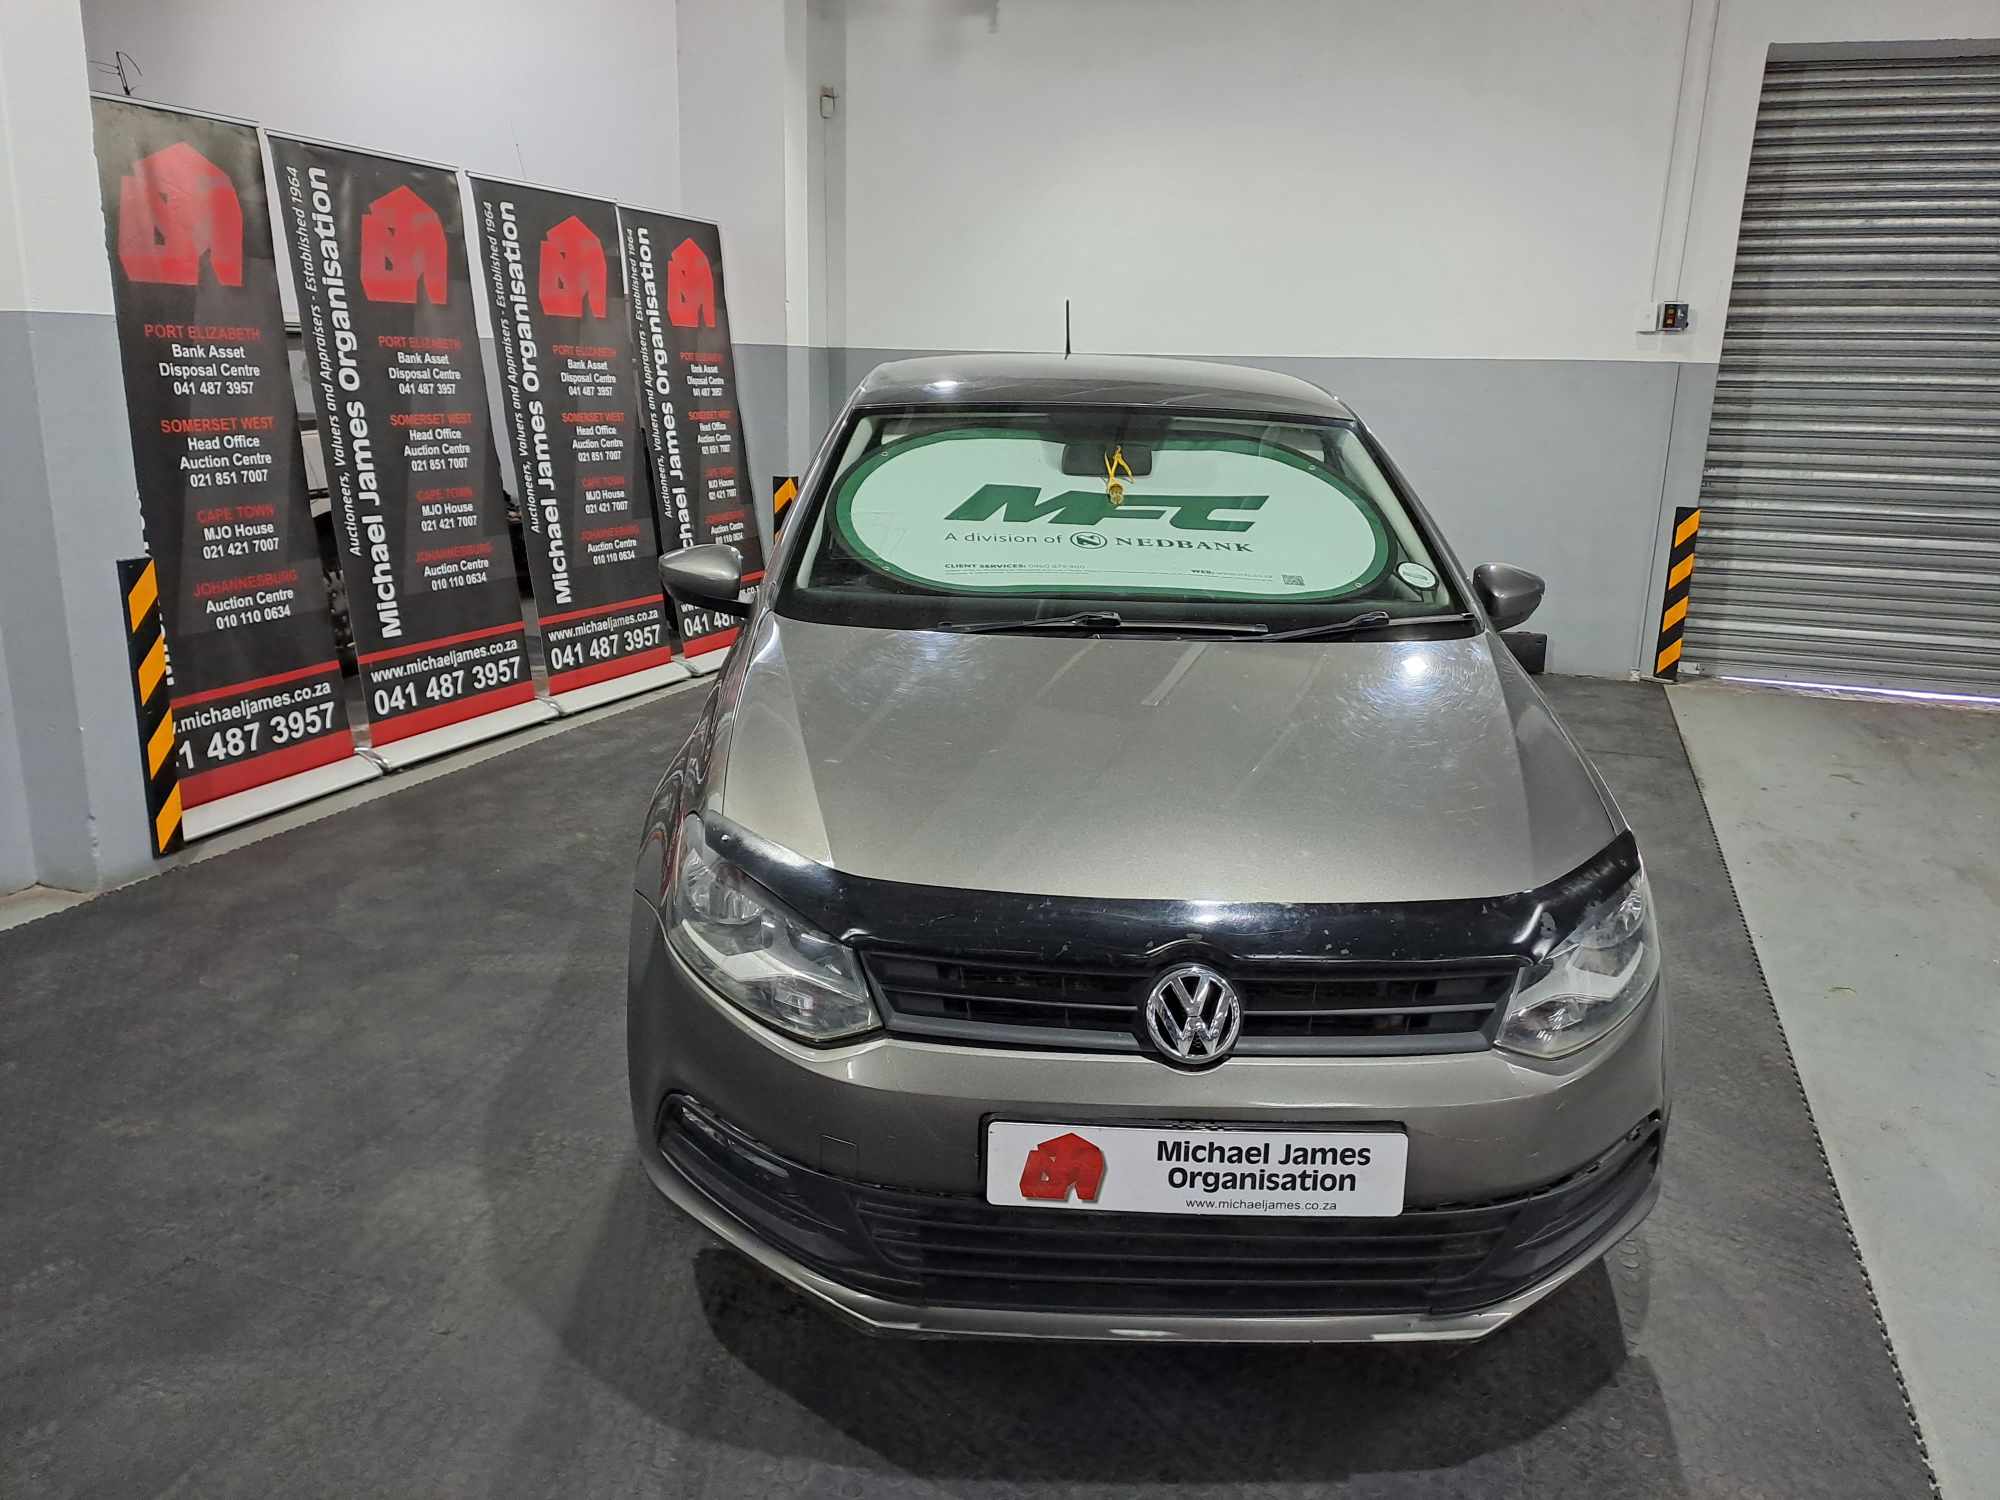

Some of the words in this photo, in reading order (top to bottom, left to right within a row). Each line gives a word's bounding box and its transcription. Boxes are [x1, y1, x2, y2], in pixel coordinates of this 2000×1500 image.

[286, 166, 305, 205] 1964
[483, 201, 497, 235] 1964
[292, 208, 317, 293] Established
[308, 167, 360, 392] Organisation
[487, 235, 506, 307] Established
[499, 201, 540, 393] Organisation
[630, 258, 644, 321] Established
[638, 227, 670, 395] Organisation
[144, 324, 184, 339] PORT
[188, 325, 261, 341] ELIZABETH
[310, 305, 333, 383] Appraisers
[378, 335, 406, 348] PORT
[172, 343, 206, 358] Bank
[209, 345, 246, 358] Asset
[397, 352, 422, 364] Bank
[424, 352, 450, 364] Asset
[500, 317, 519, 385] Appraisers
[639, 330, 653, 388] Appraisers
[159, 363, 217, 379] Disposal
[221, 363, 261, 377] Centre
[388, 367, 430, 381] Disposal
[432, 368, 461, 379] Centre
[567, 359, 586, 370] Bank
[587, 360, 608, 370] Asset
[174, 381, 196, 395] 041
[200, 381, 222, 395] 487
[226, 381, 254, 394] 3957
[399, 383, 415, 395] 041
[418, 383, 433, 394] 487
[437, 383, 456, 394] 3957
[560, 372, 593, 384] Disposal
[321, 382, 337, 411] and
[509, 384, 522, 409] and
[161, 417, 237, 433] SOMERSET
[241, 416, 275, 430] WEST
[409, 428, 433, 440] Head
[435, 428, 461, 439] Office
[514, 411, 529, 457] Valuers
[576, 425, 594, 435] Head
[595, 425, 616, 435] Office
[188, 437, 220, 451] Head
[223, 435, 260, 449] Office
[329, 416, 345, 467] Valuers
[346, 401, 380, 506] James
[404, 445, 440, 457] Auction
[442, 443, 470, 454] Centre
[529, 400, 555, 491] James
[572, 439, 599, 449] Auction
[661, 402, 684, 481] James
[180, 454, 230, 470] Auction
[233, 453, 272, 467] Centre
[411, 460, 428, 472] 021
[430, 459, 446, 470] 851
[448, 457, 468, 469] 7007
[190, 473, 212, 487] 021
[216, 471, 238, 485] 851
[241, 469, 269, 484] 7007
[422, 504, 442, 517] MJO
[444, 502, 473, 514] House
[522, 460, 541, 535] Auctioneers,
[944, 484, 1270, 532] MFC
[197, 508, 232, 523] CAPE
[237, 504, 275, 519] TOWN
[336, 472, 362, 556] Auctioneers,
[421, 520, 437, 532] 021
[440, 518, 455, 529] 421
[457, 515, 477, 527] 7007
[204, 526, 232, 541] MJO
[235, 523, 274, 538] House
[944, 532, 959, 543] A
[965, 532, 1044, 545] division
[1048, 532, 1063, 544] of
[1115, 537, 1255, 552] NEDBANK
[203, 545, 223, 559] 021
[228, 542, 249, 556] 421
[253, 537, 280, 553] 7007
[540, 498, 572, 604] Michael
[587, 541, 613, 553] Auction
[361, 515, 402, 639] Michael
[424, 563, 458, 577] Auction
[460, 559, 489, 571] Centre
[431, 579, 447, 591] 010
[449, 575, 464, 587] 110
[466, 571, 488, 585] 0634
[206, 597, 253, 614] Auction
[256, 589, 294, 605] Centre
[216, 615, 238, 630] 010
[240, 610, 262, 626] 110
[264, 605, 291, 621] 0634
[548, 608, 659, 642] www.michaeljames.co.za
[683, 613, 710, 637] 041
[550, 642, 584, 670] 041
[589, 634, 618, 662] 487
[624, 624, 661, 652] 3957
[370, 639, 518, 684] www.michaeljames.co.za
[373, 681, 419, 717] 041
[425, 669, 466, 701] 487
[471, 655, 521, 690] 3957
[174, 682, 332, 733] .michaeljames.co.za
[207, 722, 260, 761] 487
[269, 701, 335, 744] 3957
[1156, 1140, 1271, 1165] Michael
[1278, 1143, 1371, 1167] James
[1167, 1167, 1357, 1193] Organisation
[1185, 1199, 1338, 1213] www.michaeljames.co.za
